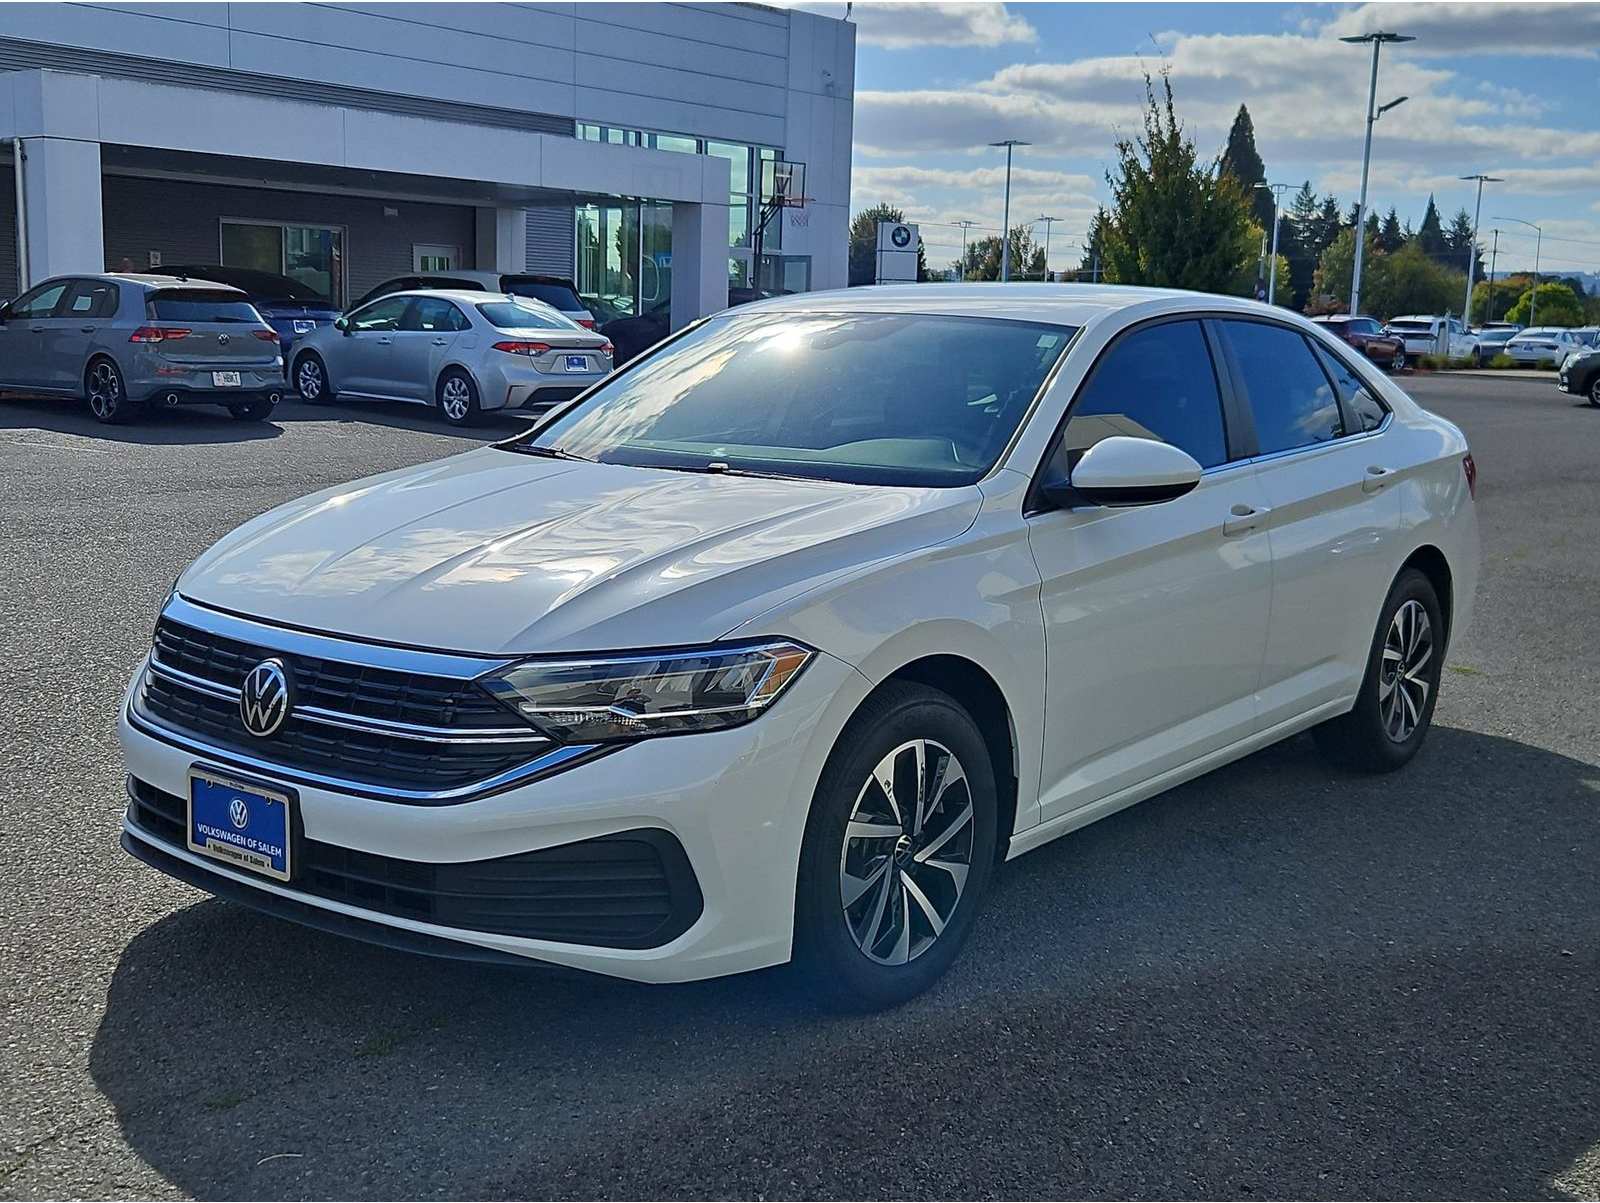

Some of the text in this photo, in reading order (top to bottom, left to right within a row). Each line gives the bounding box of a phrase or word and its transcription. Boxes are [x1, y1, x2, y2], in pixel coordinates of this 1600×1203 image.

[197, 823, 282, 857] VOLKSWAGEN OF SALEM
